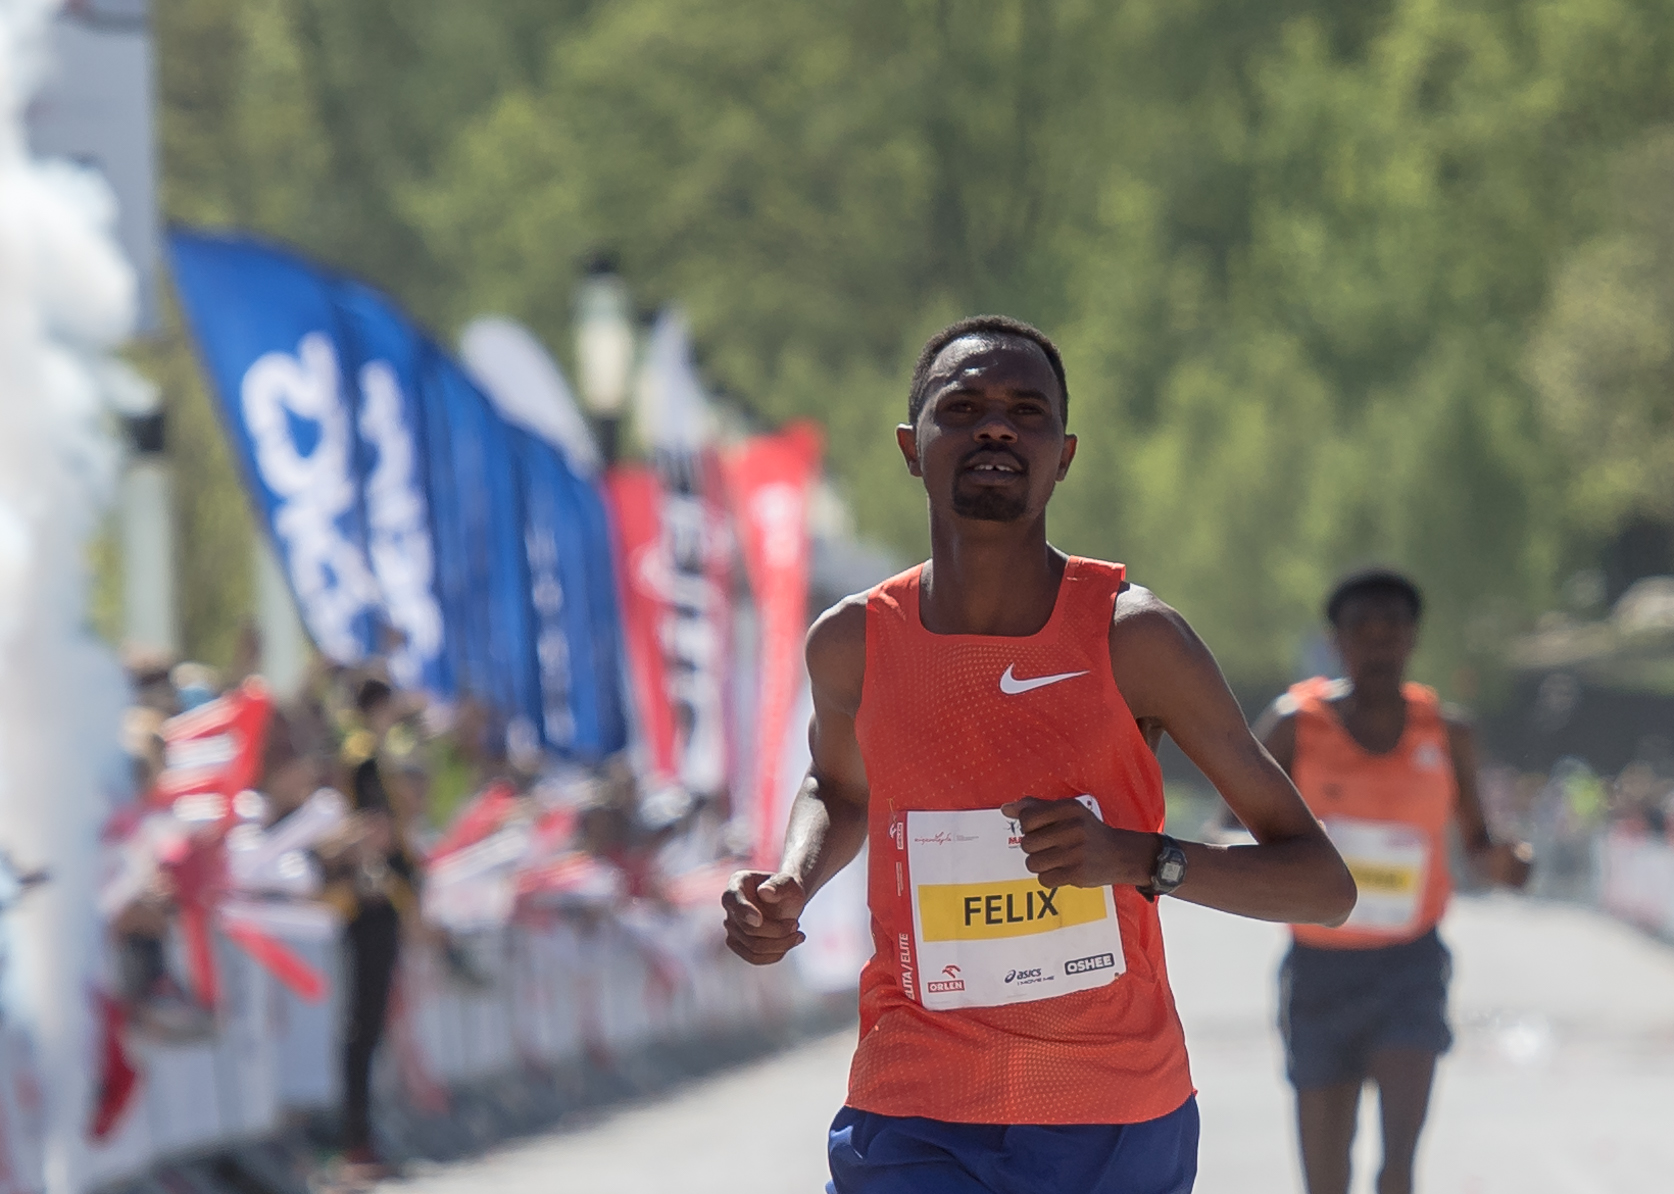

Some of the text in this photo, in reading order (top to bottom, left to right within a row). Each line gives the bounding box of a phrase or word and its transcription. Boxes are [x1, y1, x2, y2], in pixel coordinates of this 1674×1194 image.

[964, 887, 1059, 926] FELIX
[1066, 954, 1112, 973] OSHEE
[1017, 968, 1042, 980] asics
[929, 981, 963, 991] ORLEN
